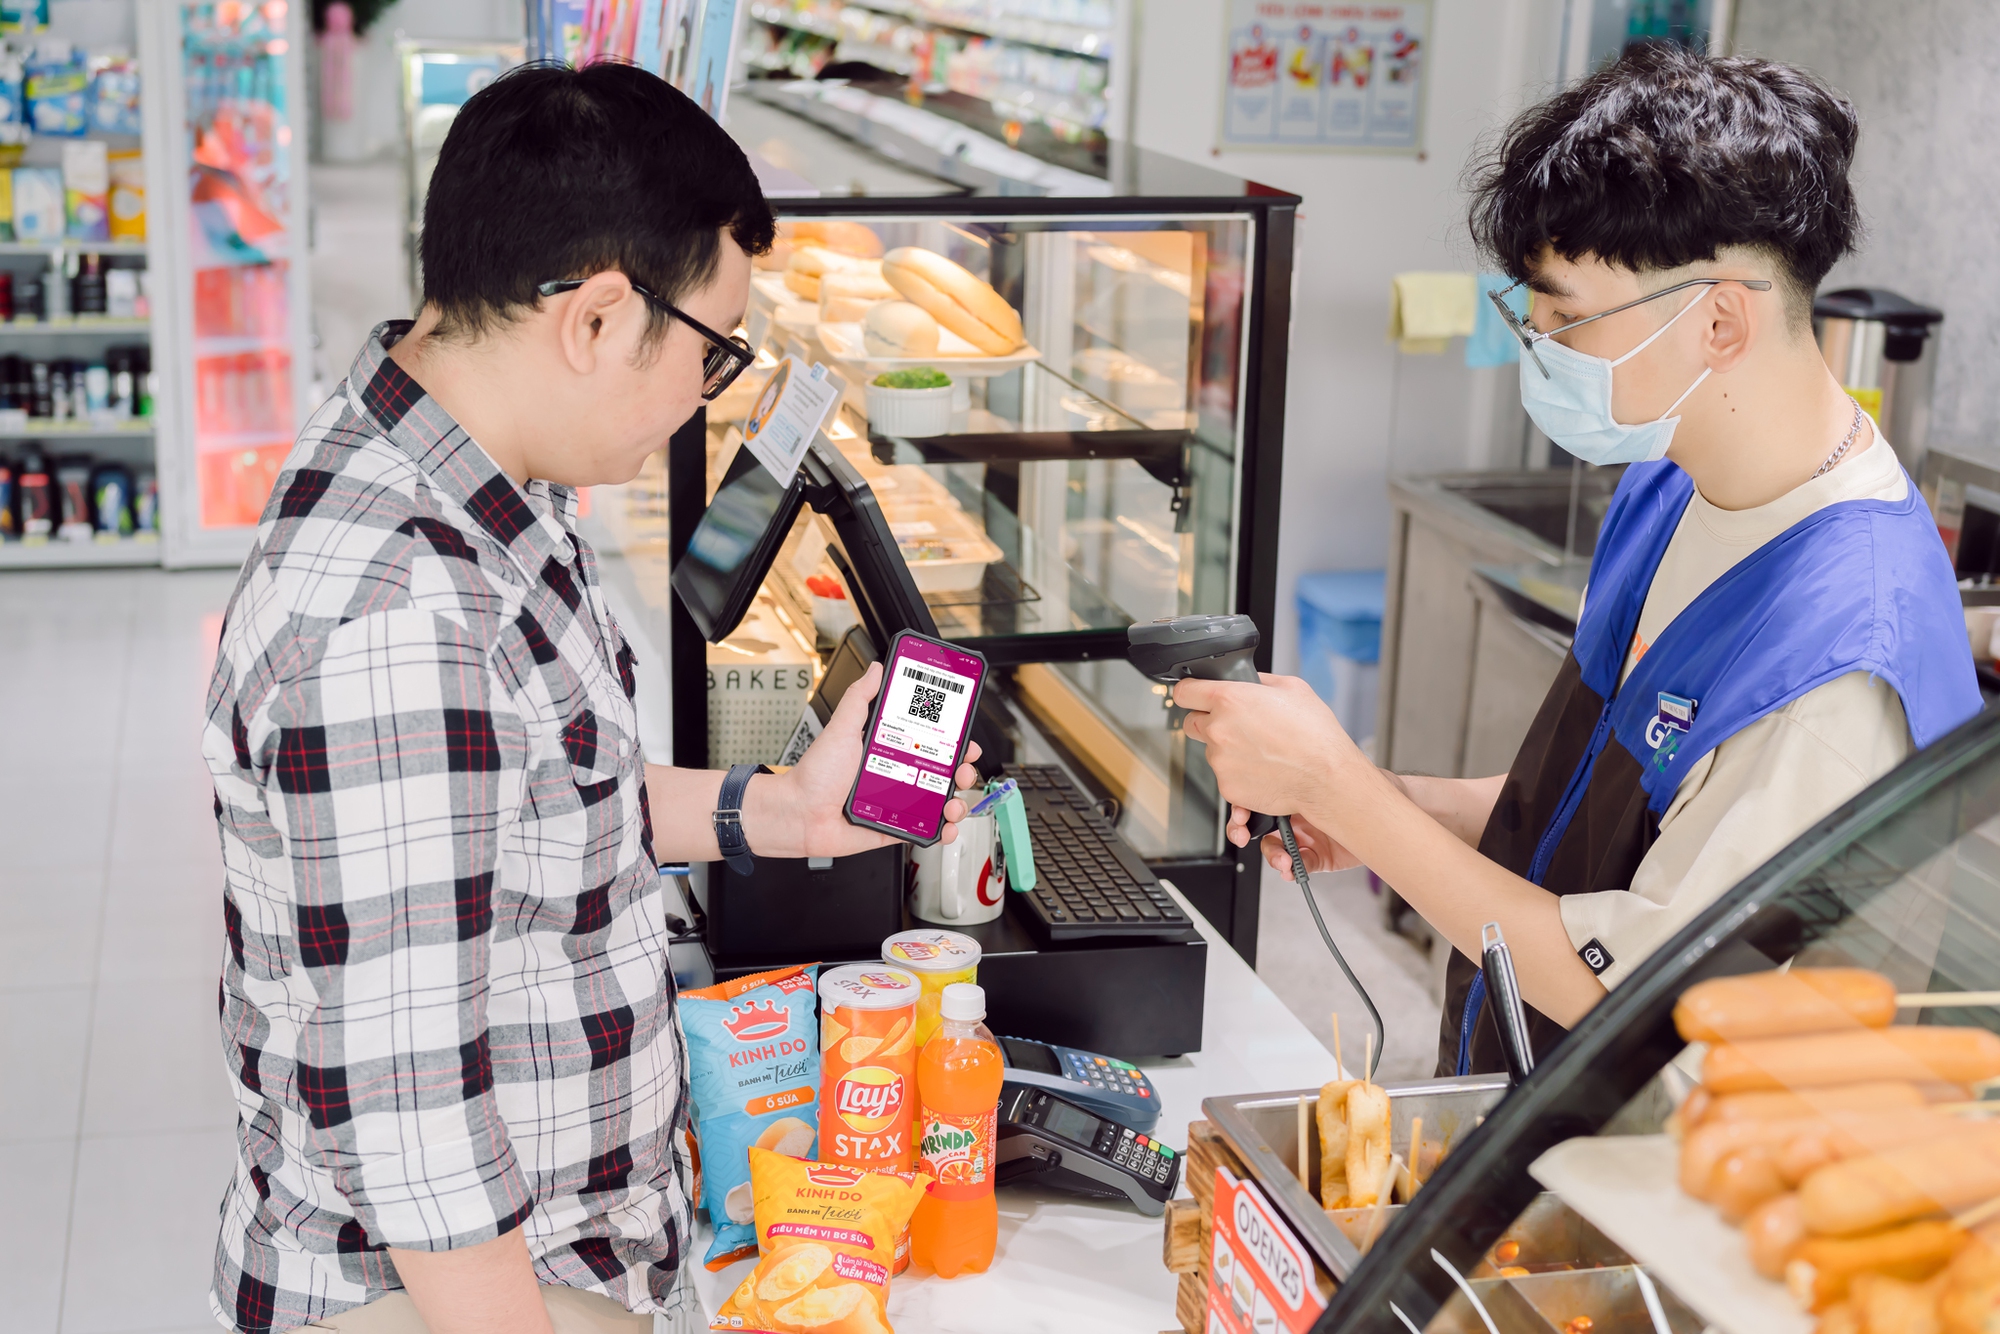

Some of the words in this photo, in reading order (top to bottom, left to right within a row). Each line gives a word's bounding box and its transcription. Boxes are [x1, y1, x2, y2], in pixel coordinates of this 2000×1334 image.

[707, 669, 810, 690] BAKES
[834, 979, 876, 999] STAX
[728, 1044, 776, 1068] KINH
[779, 1038, 806, 1056] DO
[776, 1093, 800, 1107] SỮA
[840, 1080, 902, 1118] Lay's
[835, 1132, 902, 1160] STAX
[920, 1127, 976, 1158] MIRINDA
[796, 1188, 835, 1200] KINH
[838, 1191, 862, 1202] DO
[772, 1223, 792, 1234] SIÊU
[820, 1229, 831, 1239] VỊ
[1238, 1202, 1300, 1301] ODEN25
